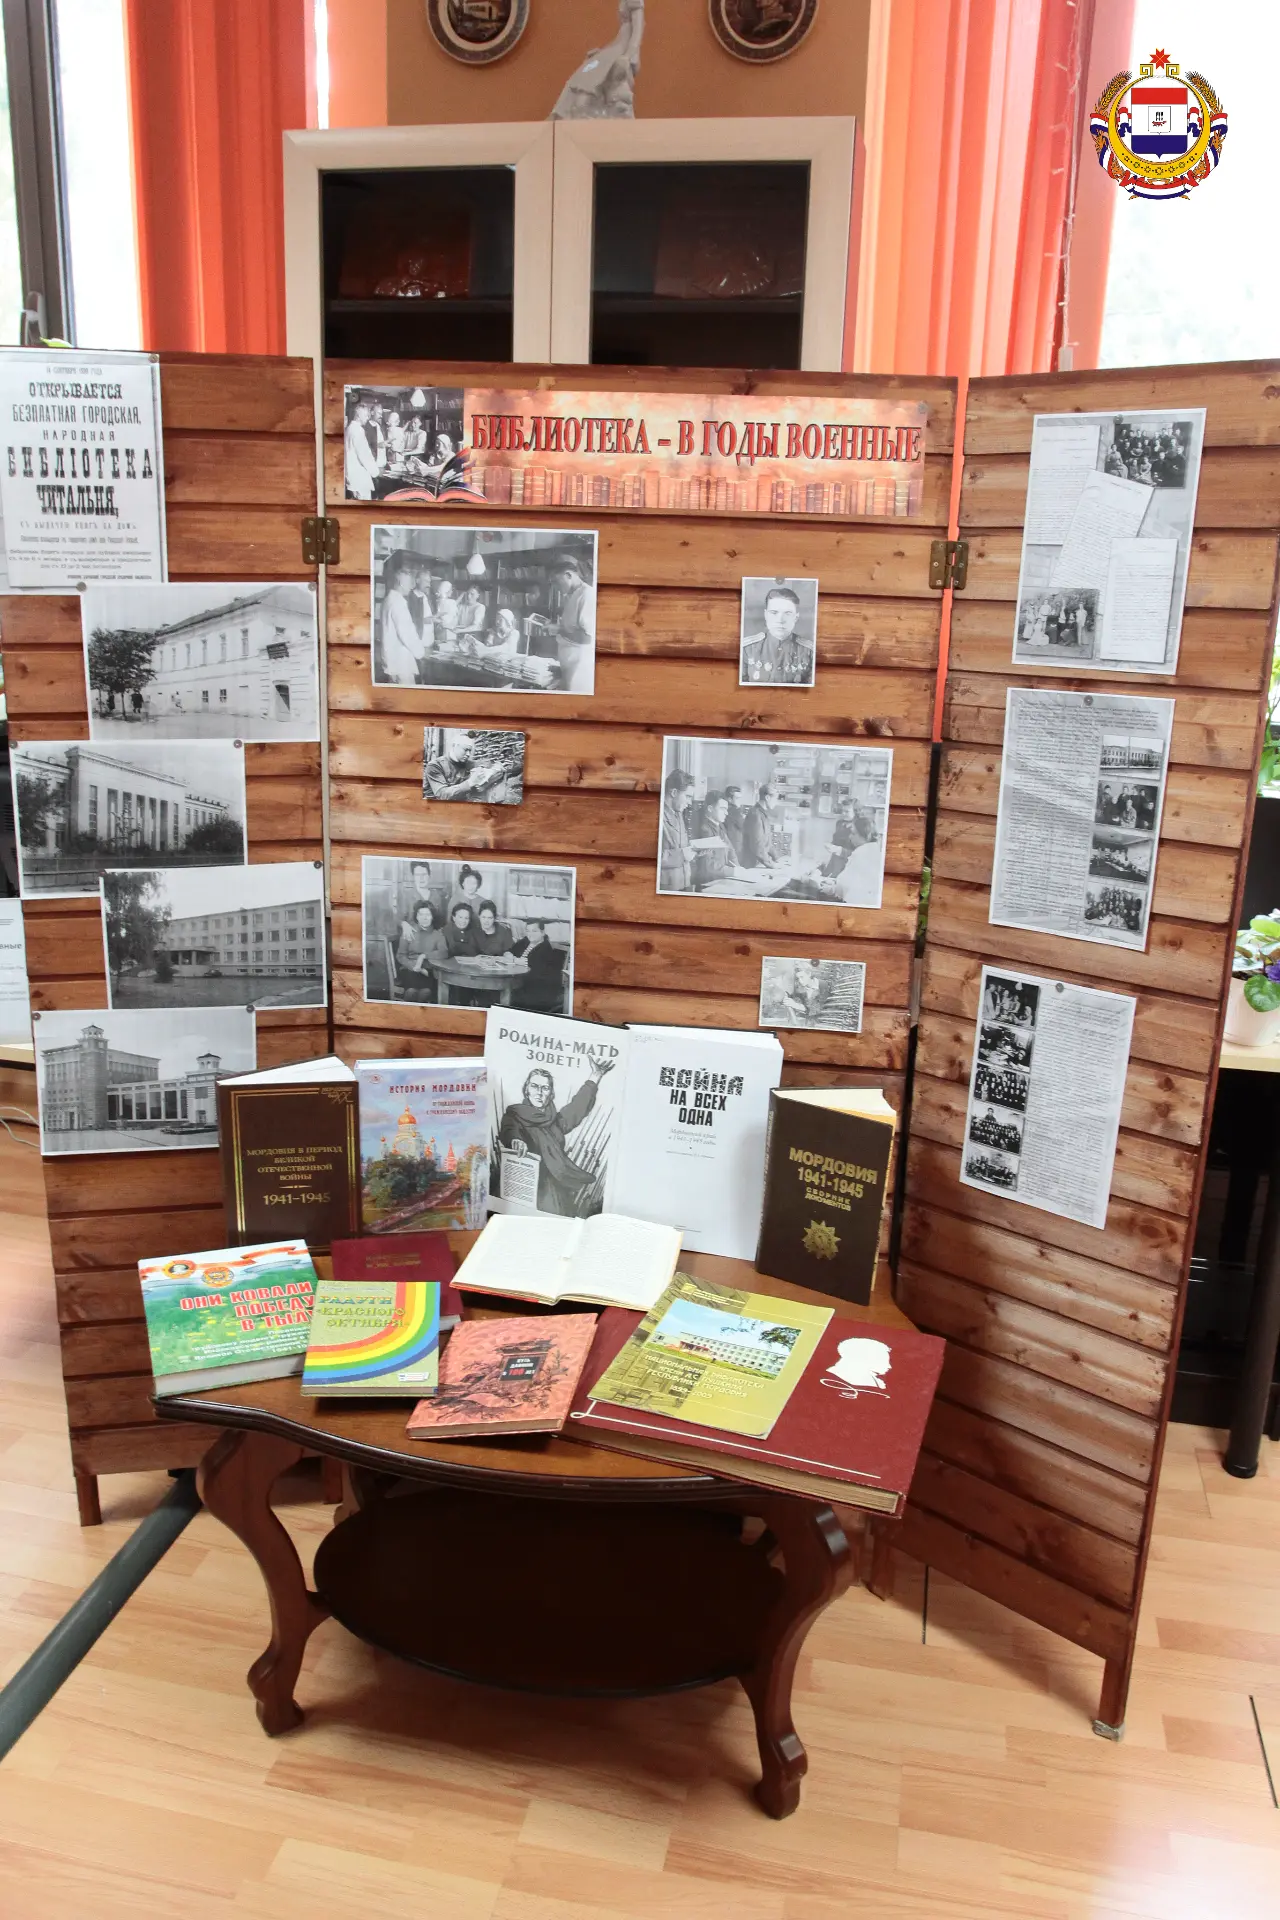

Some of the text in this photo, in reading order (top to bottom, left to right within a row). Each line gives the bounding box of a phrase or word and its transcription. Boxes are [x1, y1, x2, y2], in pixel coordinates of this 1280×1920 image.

[28, 382, 122, 399] ОТКРЫВАЕТСЯ
[12, 404, 76, 422] БЕЗПЛАТНАЯ
[43, 430, 115, 442] НАРОДНАЯ
[471, 414, 652, 454] БИБЛИОТЕКА
[676, 420, 695, 456] В
[701, 421, 781, 467] ГОДЫ
[785, 423, 923, 463] ВОЕННЫЕ
[7, 446, 153, 479] БИБЛІОТЕКА
[499, 1027, 620, 1058] РОДИНА-МАТЬ
[526, 1049, 581, 1068] ЗОВЕТ!
[389, 1083, 477, 1093] ИСТОРИЯ МОРДОВИИ
[658, 1066, 745, 1097] ВОЙНА
[669, 1088, 728, 1112] НА ВСЕХ
[678, 1107, 714, 1127] ОДНА
[246, 1147, 296, 1156] МОРДОВИЯ
[306, 1146, 343, 1154] ПЕРИОД
[274, 1156, 316, 1164] ВЕЛИКОЙ
[257, 1163, 333, 1173] ОТЕЧЕСТВЕННОЙ
[789, 1147, 878, 1185] МОРДОВИЯ
[797, 1166, 864, 1199] 1941-1945
[804, 1192, 852, 1212] ДОКУМЕНТОВ
[806, 1186, 851, 1205] СБОРНИК
[180, 1294, 222, 1310] ОНИ
[230, 1281, 313, 1304] КОВАЛИ
[235, 1295, 315, 1317] ПОБЕДУ
[241, 1318, 255, 1332] В
